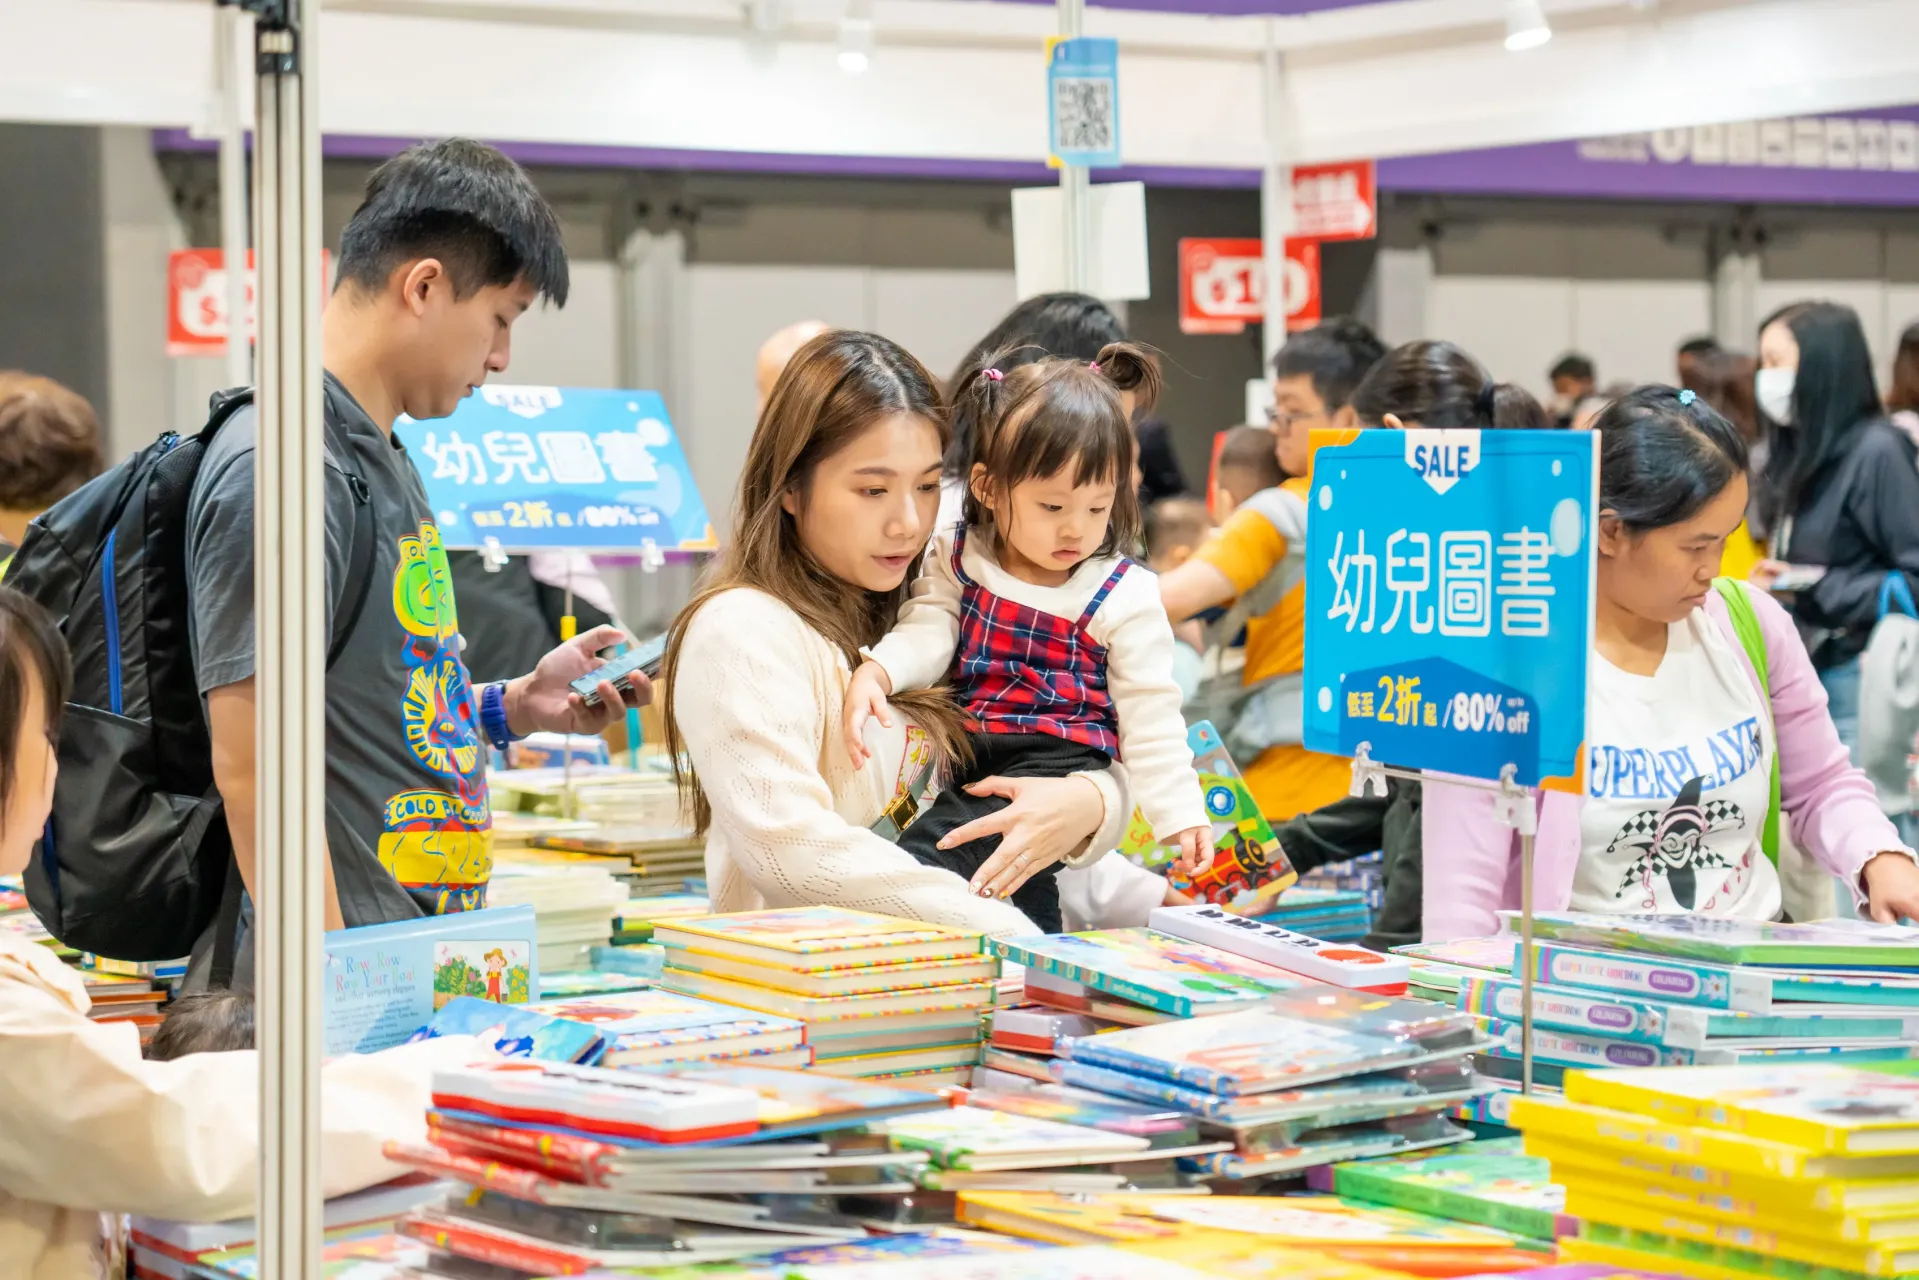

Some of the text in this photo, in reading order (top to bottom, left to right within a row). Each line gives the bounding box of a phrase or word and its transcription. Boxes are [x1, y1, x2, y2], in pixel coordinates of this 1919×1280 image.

[1414, 445, 1470, 479] SALE
[1327, 525, 1557, 638] 幼兒圖書
[1507, 711, 1529, 734] off
[396, 799, 436, 819] COLD
[346, 951, 401, 974] Row Row
[335, 974, 360, 992] Row
